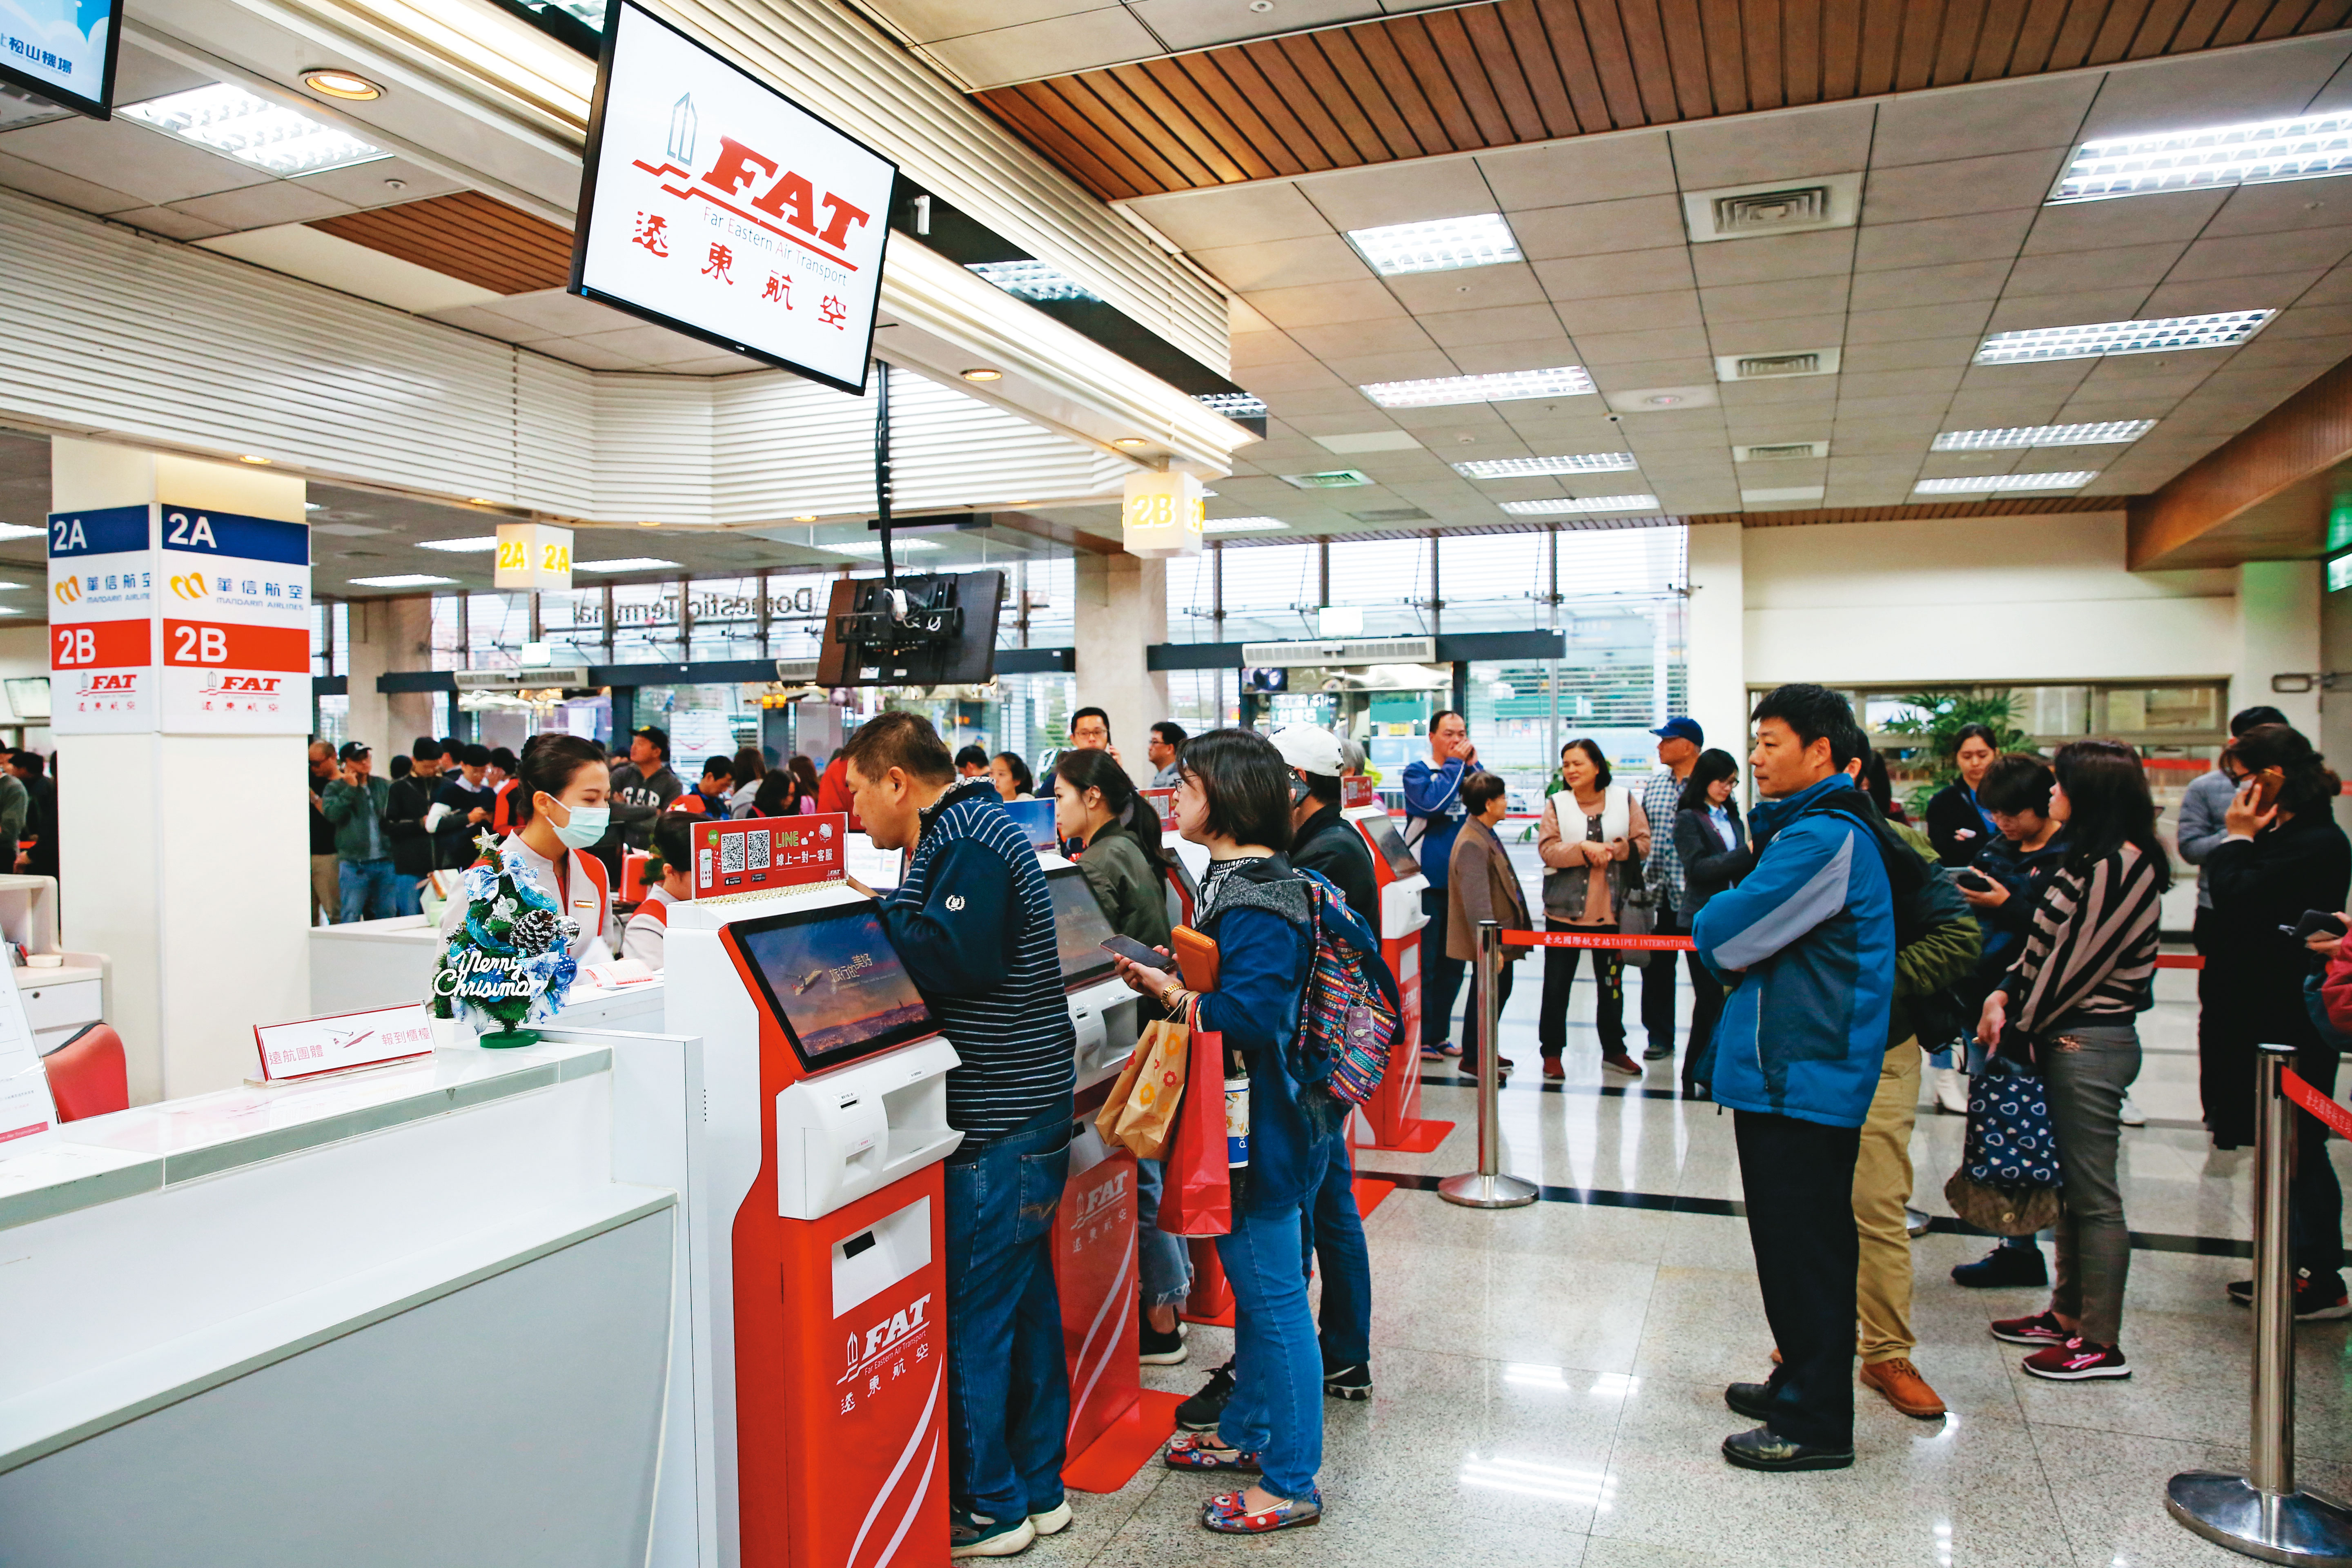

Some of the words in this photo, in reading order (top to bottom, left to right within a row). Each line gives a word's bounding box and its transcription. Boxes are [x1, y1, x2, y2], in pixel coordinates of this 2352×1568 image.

[702, 135, 870, 251] FAT
[704, 207, 724, 227] Far
[728, 218, 773, 251] Eastern
[775, 242, 792, 259] Air
[796, 249, 847, 286] Transport
[1132, 494, 1176, 529] 2B
[53, 519, 87, 551] 2A
[168, 513, 217, 548] 2A
[499, 541, 529, 570] 2A
[540, 543, 570, 574] 2A
[125, 593, 150, 601] AIRLINE
[217, 577, 303, 599] 華信航空
[58, 628, 96, 664] 2B
[174, 626, 228, 663] 2B
[91, 674, 137, 689] FAT
[221, 677, 281, 691] FAT
[776, 831, 799, 848] LINE
[776, 849, 833, 866] 線上一對一客服
[1611, 938, 1637, 947] TAIPEI
[452, 950, 523, 980] Merry
[829, 953, 873, 982] 旅行的美好
[434, 968, 532, 998] Christma
[268, 1044, 324, 1065] 遠航團體
[381, 1027, 432, 1046] 報到櫃檯
[1085, 1170, 1128, 1214] FAT
[861, 1292, 931, 1361] FAT
[874, 1353, 893, 1370] Eastern
[902, 1330, 926, 1350] Transport
